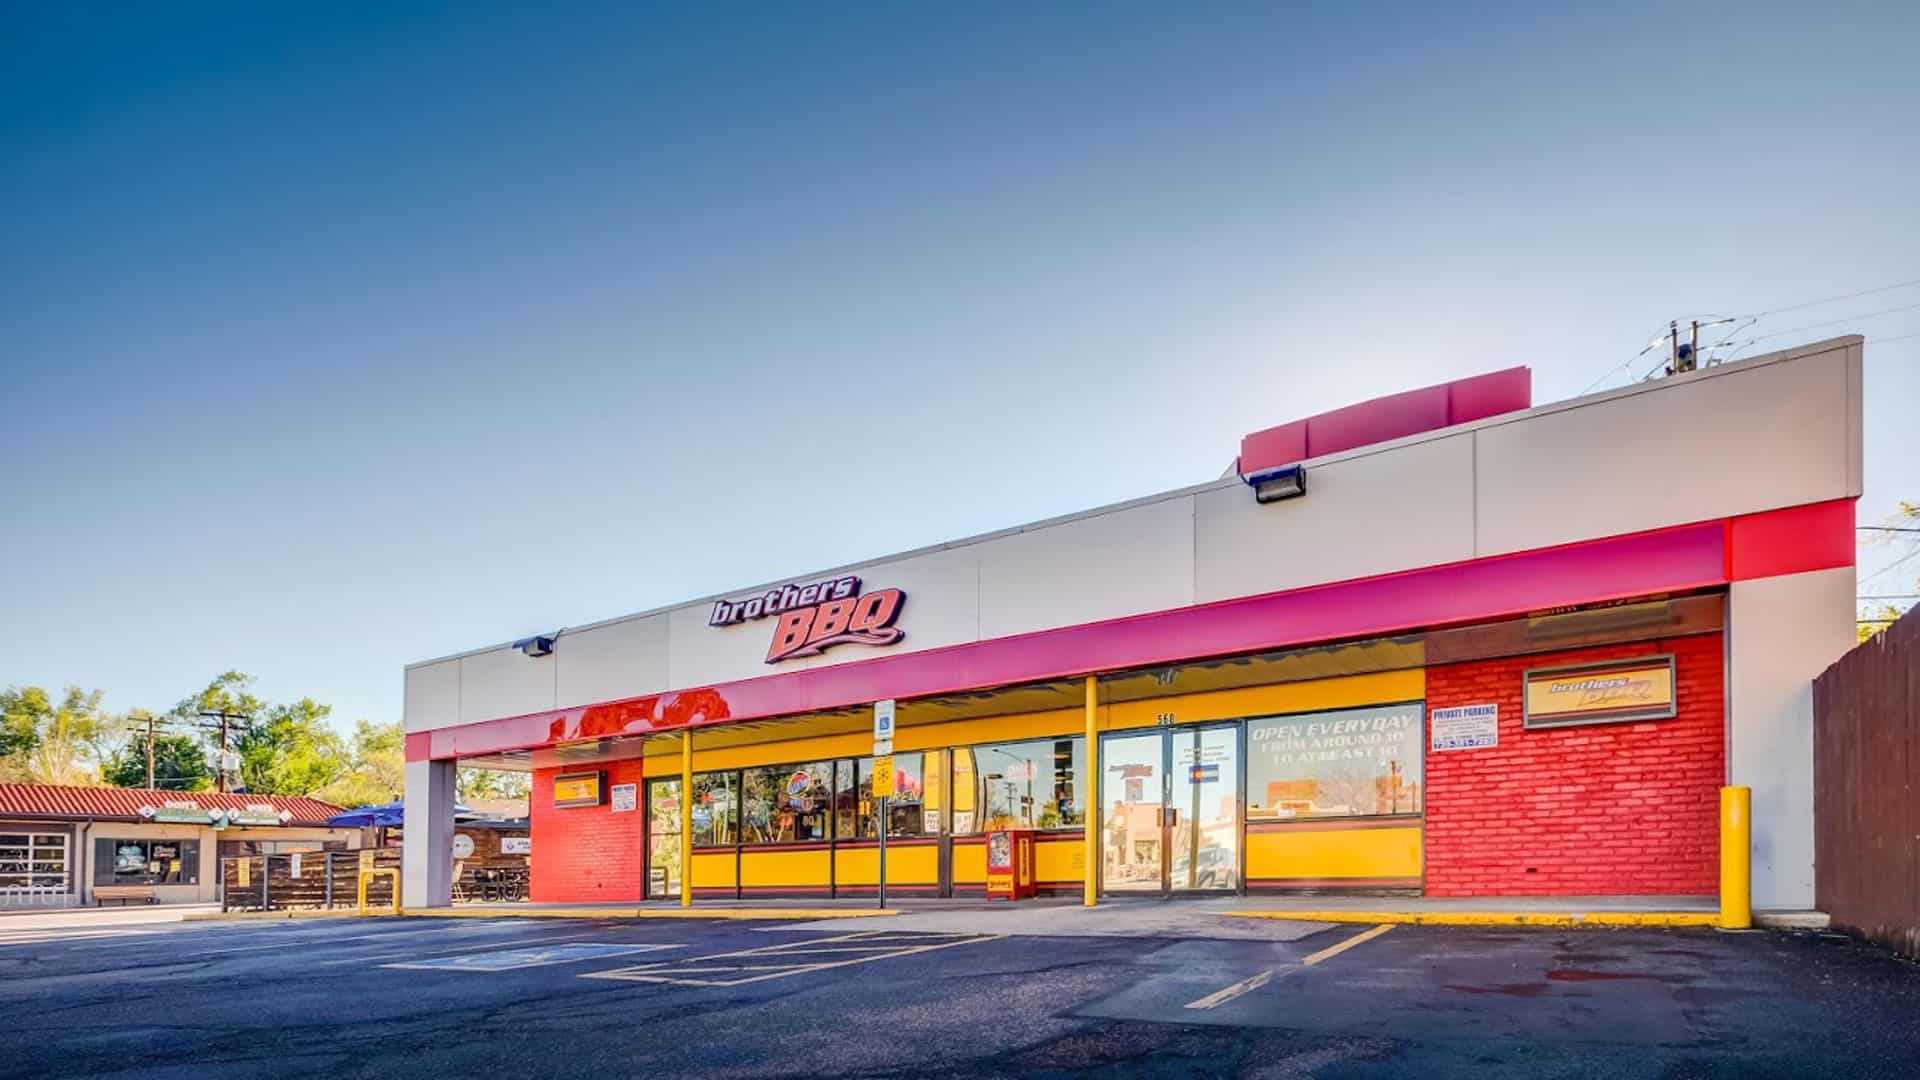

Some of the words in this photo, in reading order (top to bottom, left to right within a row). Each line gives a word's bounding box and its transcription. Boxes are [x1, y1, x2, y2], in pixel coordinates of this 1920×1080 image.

[710, 575, 862, 626] brothers
[765, 587, 907, 664] BBQ
[1252, 724, 1303, 741] OPEN
